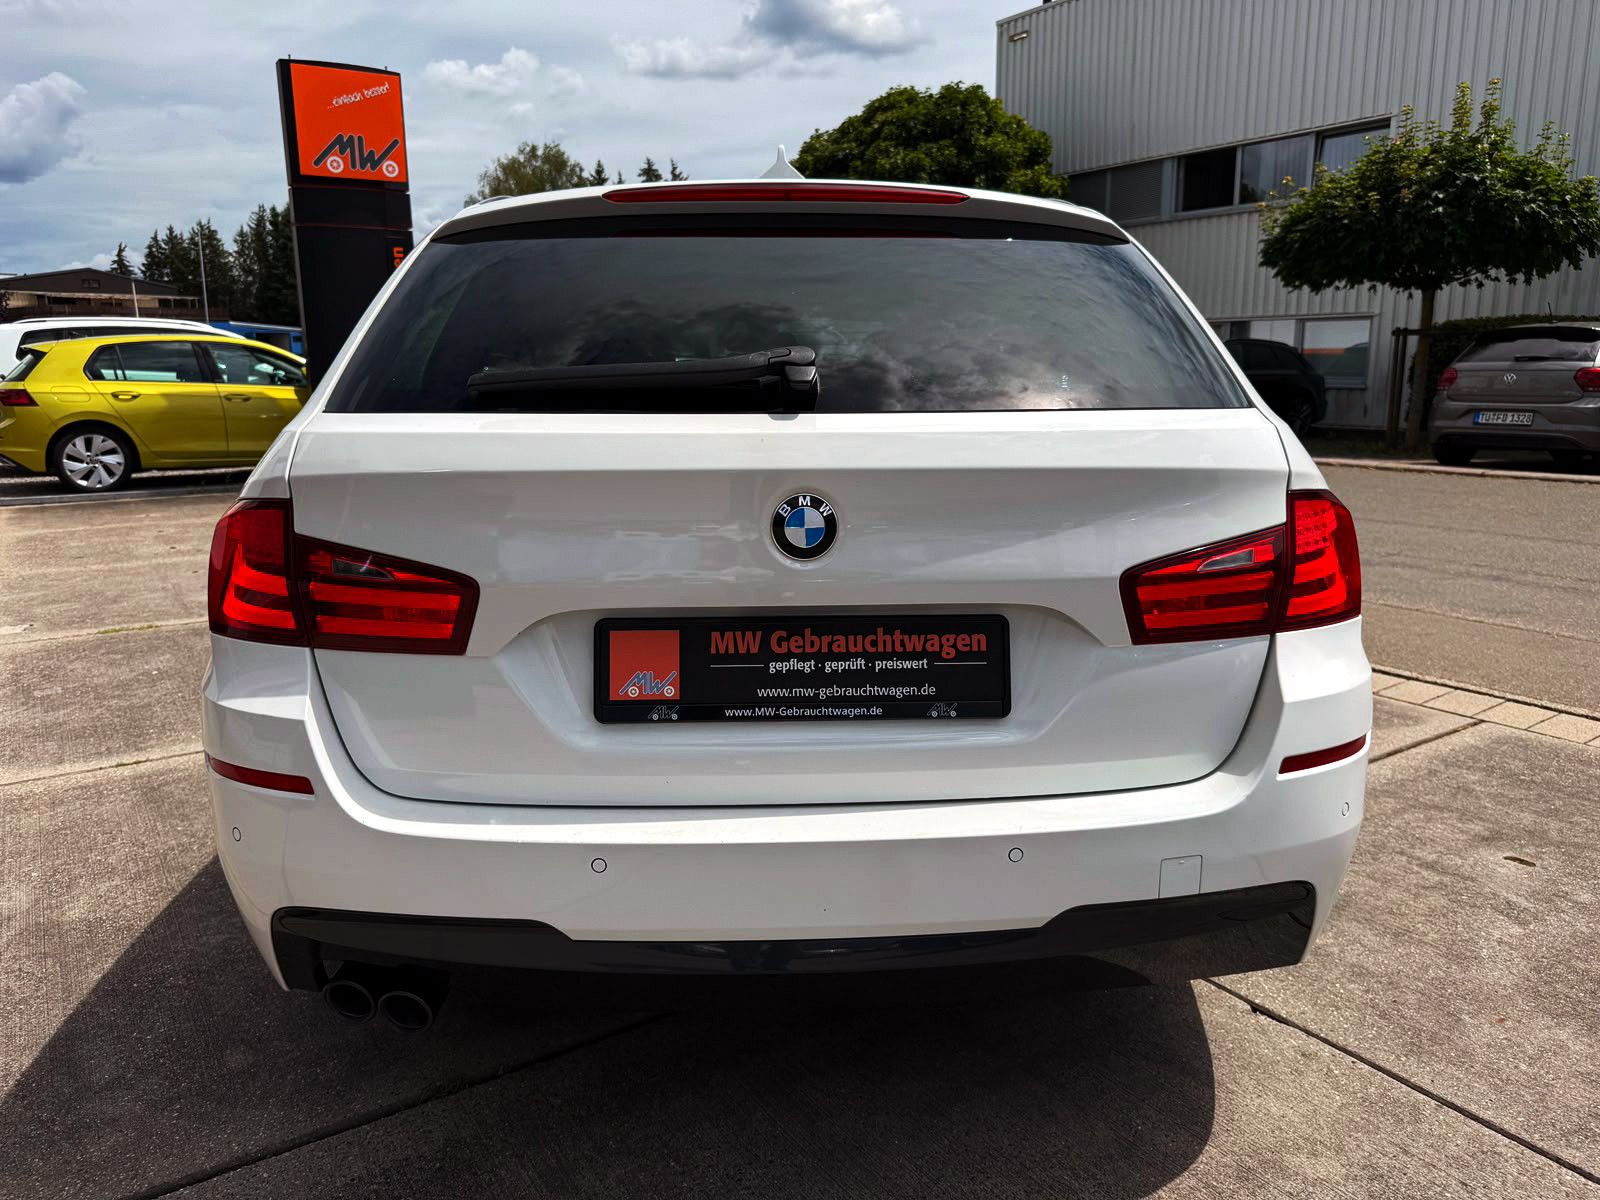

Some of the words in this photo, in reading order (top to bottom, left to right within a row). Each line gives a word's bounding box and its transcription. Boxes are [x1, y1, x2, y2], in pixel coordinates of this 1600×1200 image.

[313, 133, 400, 173] MW
[778, 495, 833, 518] BMW
[710, 631, 762, 655] MW
[769, 627, 987, 660] Gebrauchtwagen
[768, 658, 816, 674] gepflegt
[824, 658, 866, 673] geprüft
[875, 657, 928, 673] preiswert
[757, 683, 937, 700] www.mw-gebrauchtwagen.de
[724, 705, 884, 718] www.MW-Gebrauchtwagen.de
